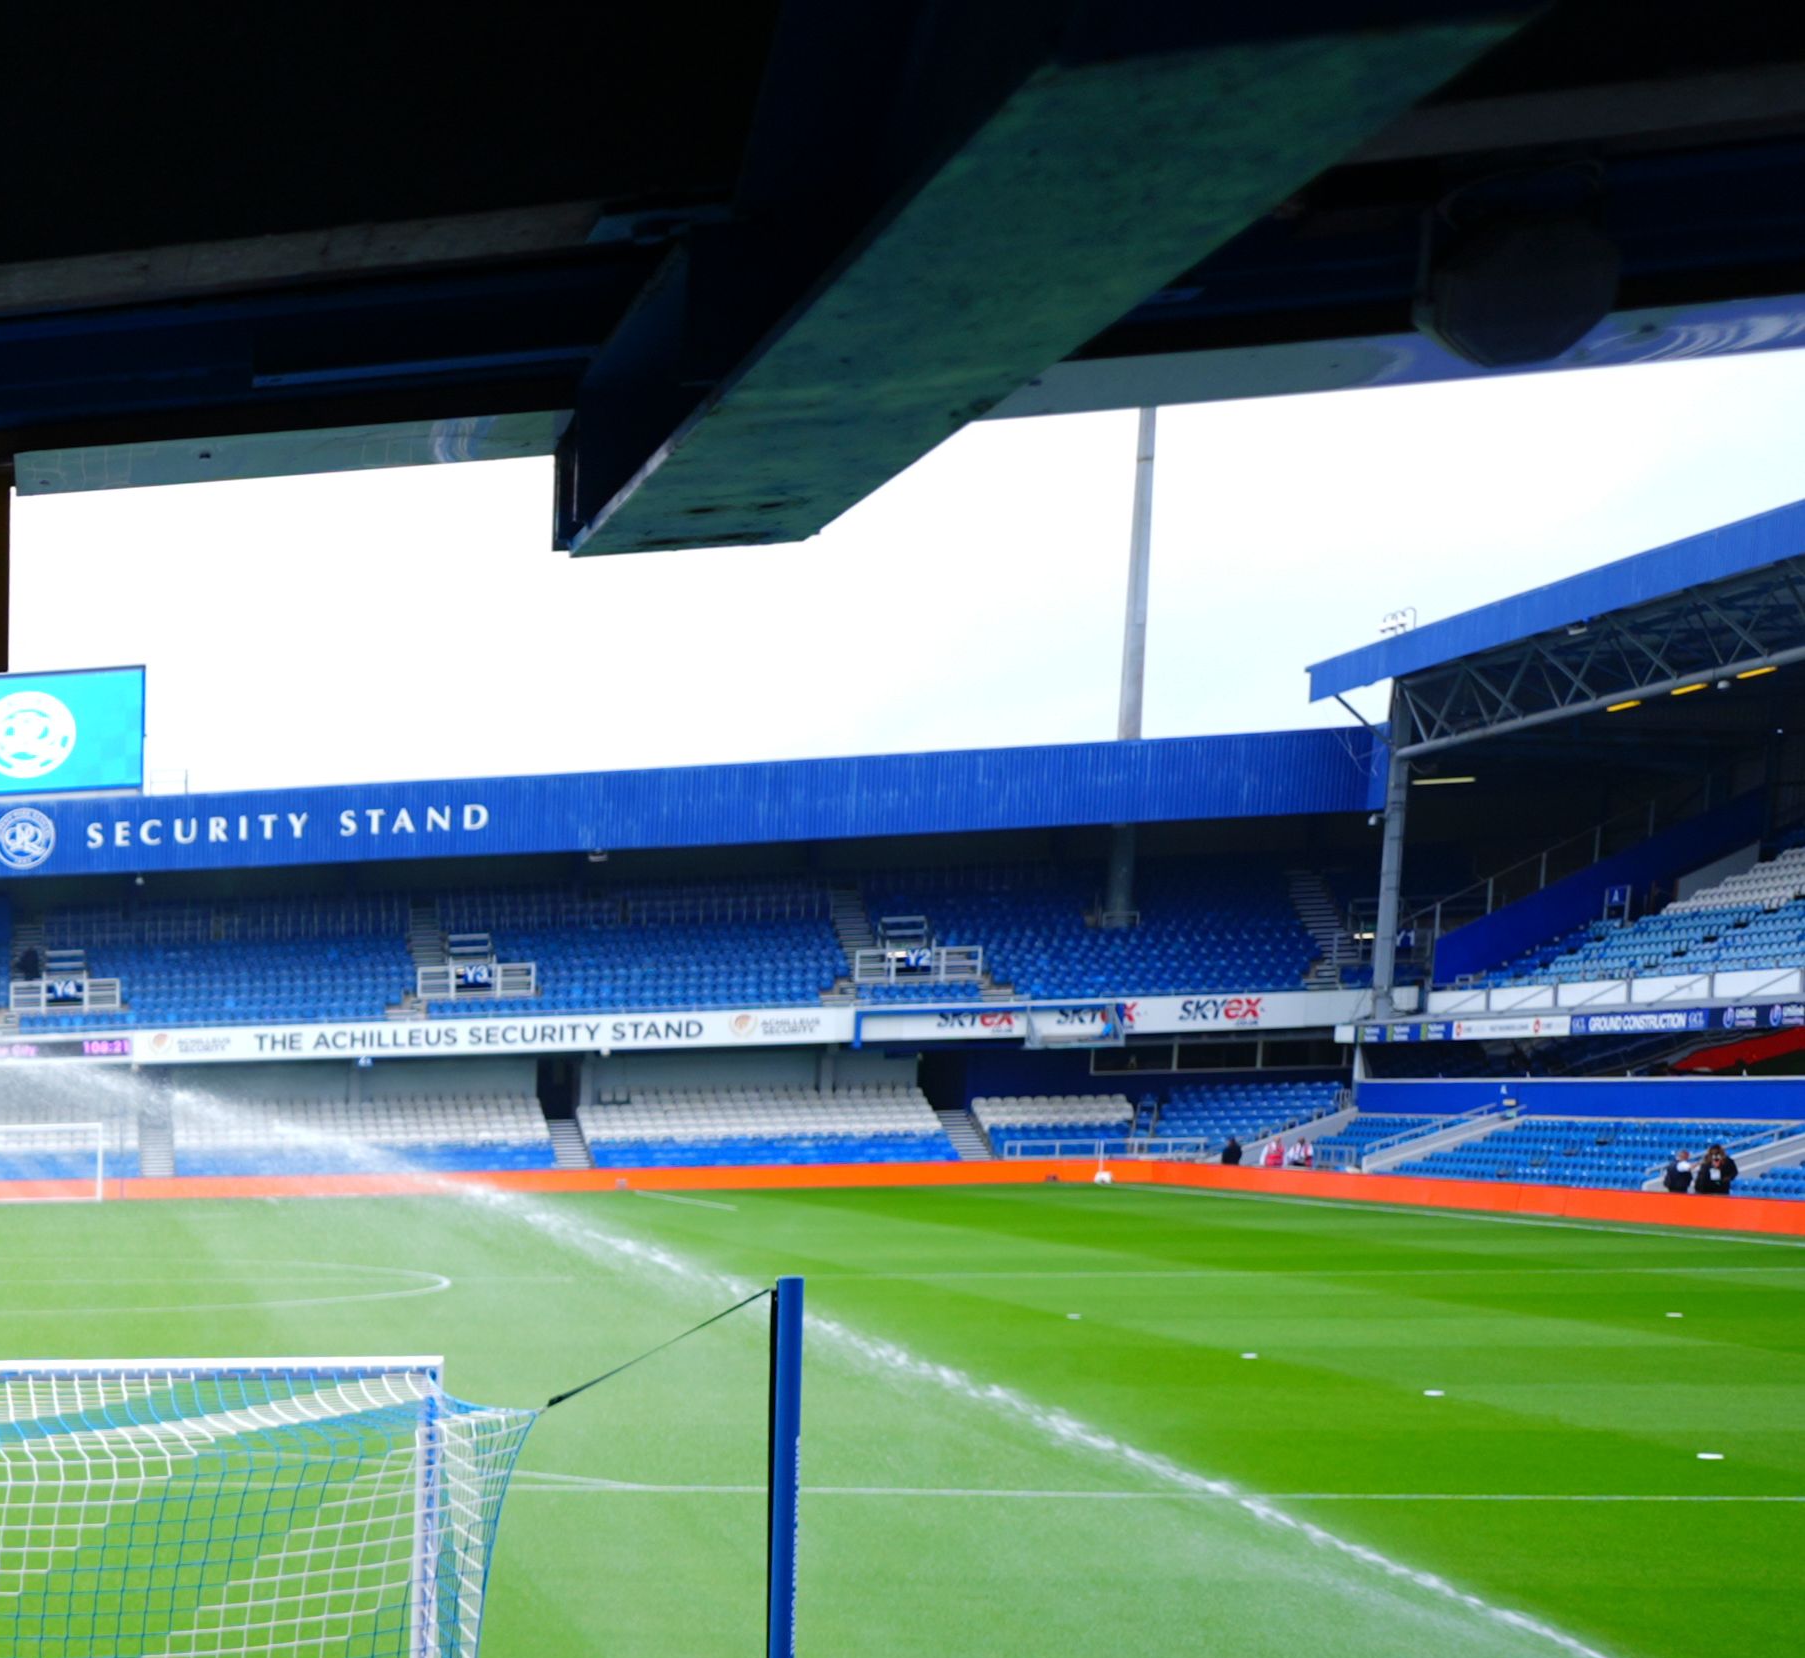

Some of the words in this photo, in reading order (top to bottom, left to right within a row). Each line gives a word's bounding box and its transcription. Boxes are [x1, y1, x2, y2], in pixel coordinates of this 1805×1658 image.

[86, 813, 309, 849] SECURITY
[339, 803, 490, 836] STAND
[907, 948, 931, 967] Y2
[464, 964, 488, 983] Y3
[53, 980, 76, 997] Y4
[1587, 1014, 1623, 1032] GROUND
[1623, 1011, 1688, 1031] CONSTRUCTION
[253, 1032, 304, 1052] THE
[313, 1026, 458, 1051] ACHILLEUS
[468, 1021, 606, 1046] SECURITY
[612, 1019, 704, 1041] STAND
